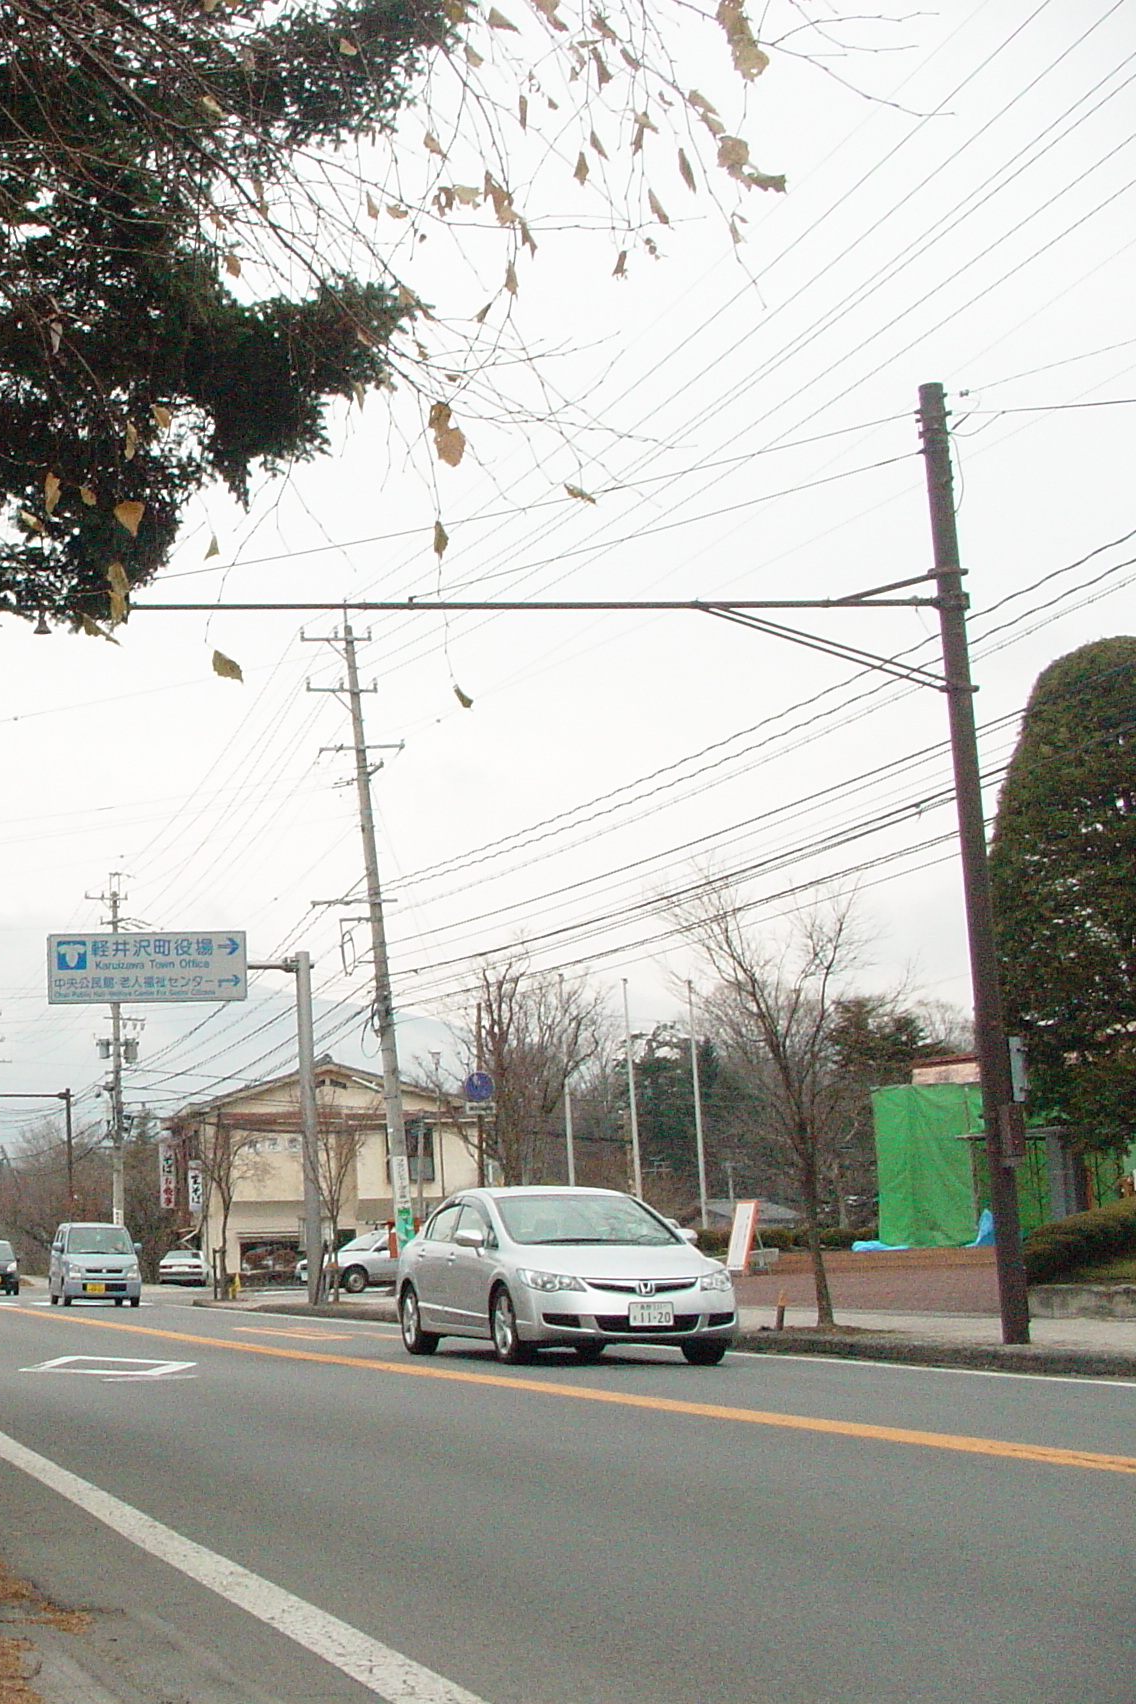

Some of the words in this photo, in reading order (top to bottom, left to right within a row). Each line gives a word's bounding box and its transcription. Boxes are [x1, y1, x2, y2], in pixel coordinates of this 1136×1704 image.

[91, 938, 213, 957] 軽井沢町役場
[95, 960, 144, 970] Karuizawa
[149, 960, 175, 969] Town
[179, 959, 210, 969] Office
[640, 1311, 671, 1324] 11-20
